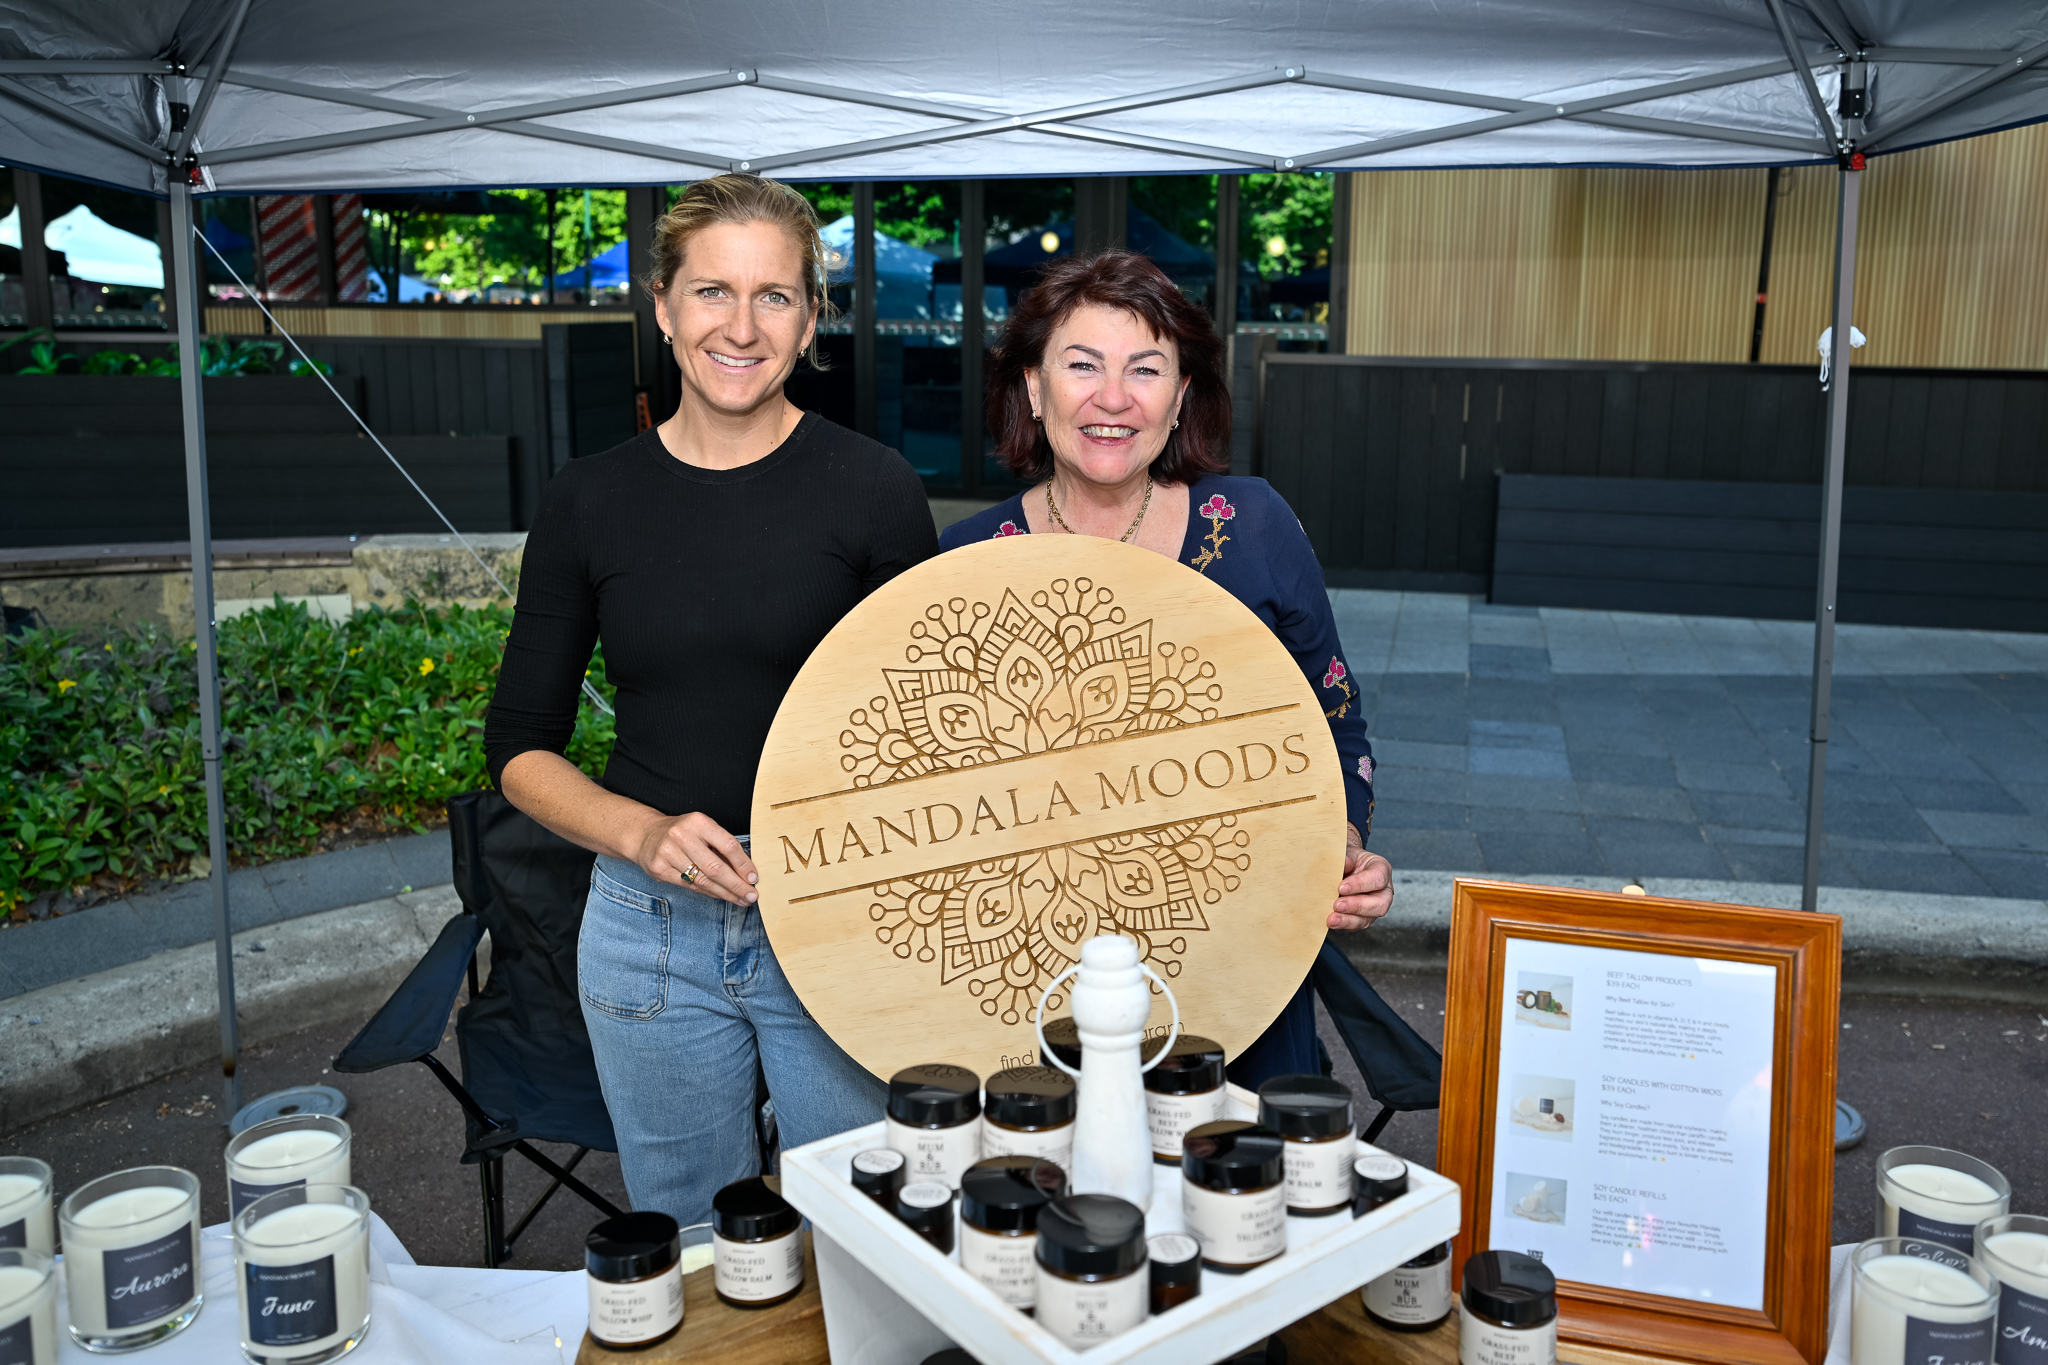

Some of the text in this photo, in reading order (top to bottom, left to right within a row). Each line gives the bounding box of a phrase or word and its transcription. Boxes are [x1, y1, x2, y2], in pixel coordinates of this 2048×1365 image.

[778, 733, 1312, 875] MANDALA MOODS
[1607, 971, 1692, 987] BEEF TALLOW PRODUCTS
[1607, 980, 1640, 990] $39 EACH
[1000, 1050, 1035, 1071] find
[1602, 1084, 1635, 1095] $39 EACH
[1603, 1075, 1723, 1097] SOY CANDLES WITH COTTON WICKS
[1594, 1184, 1667, 1200] SOY CANDLE REFILLS
[1594, 1193, 1628, 1204] $25 EACH
[110, 1262, 190, 1300] Aurora
[1394, 1279, 1420, 1289] MUM
[1397, 1296, 1417, 1305] BUB
[1402, 1288, 1411, 1297] &
[261, 1296, 317, 1317] Juno
[2002, 1326, 2048, 1350] Am
